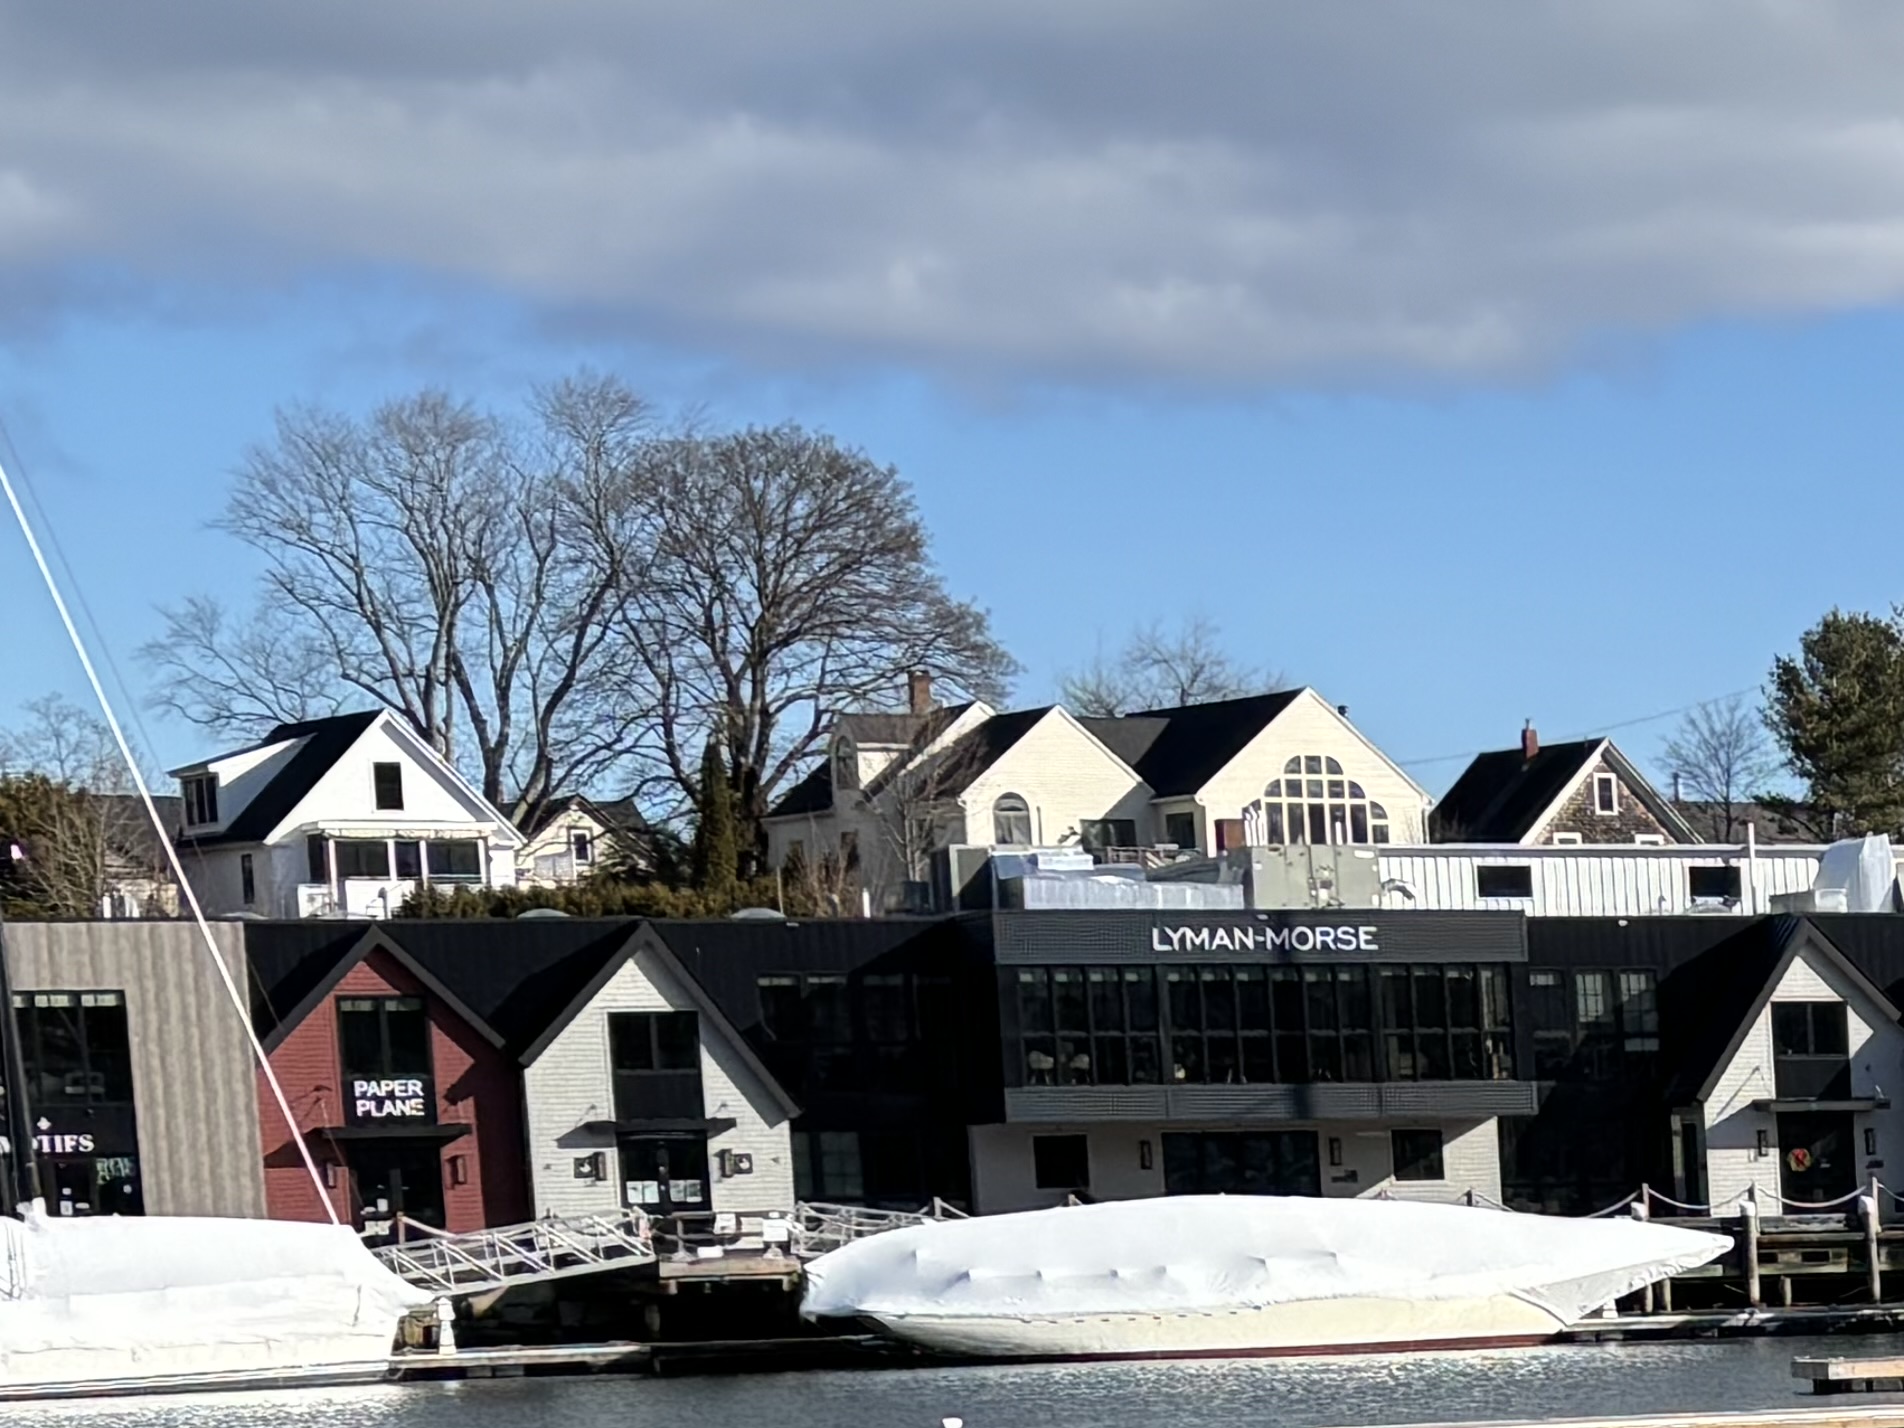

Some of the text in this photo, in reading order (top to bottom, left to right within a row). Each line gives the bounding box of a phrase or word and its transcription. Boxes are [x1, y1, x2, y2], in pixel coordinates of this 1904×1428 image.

[1152, 926, 1379, 951] LYMAN-MORSE
[353, 1079, 424, 1097] PAPER
[356, 1098, 425, 1117] PLANE
